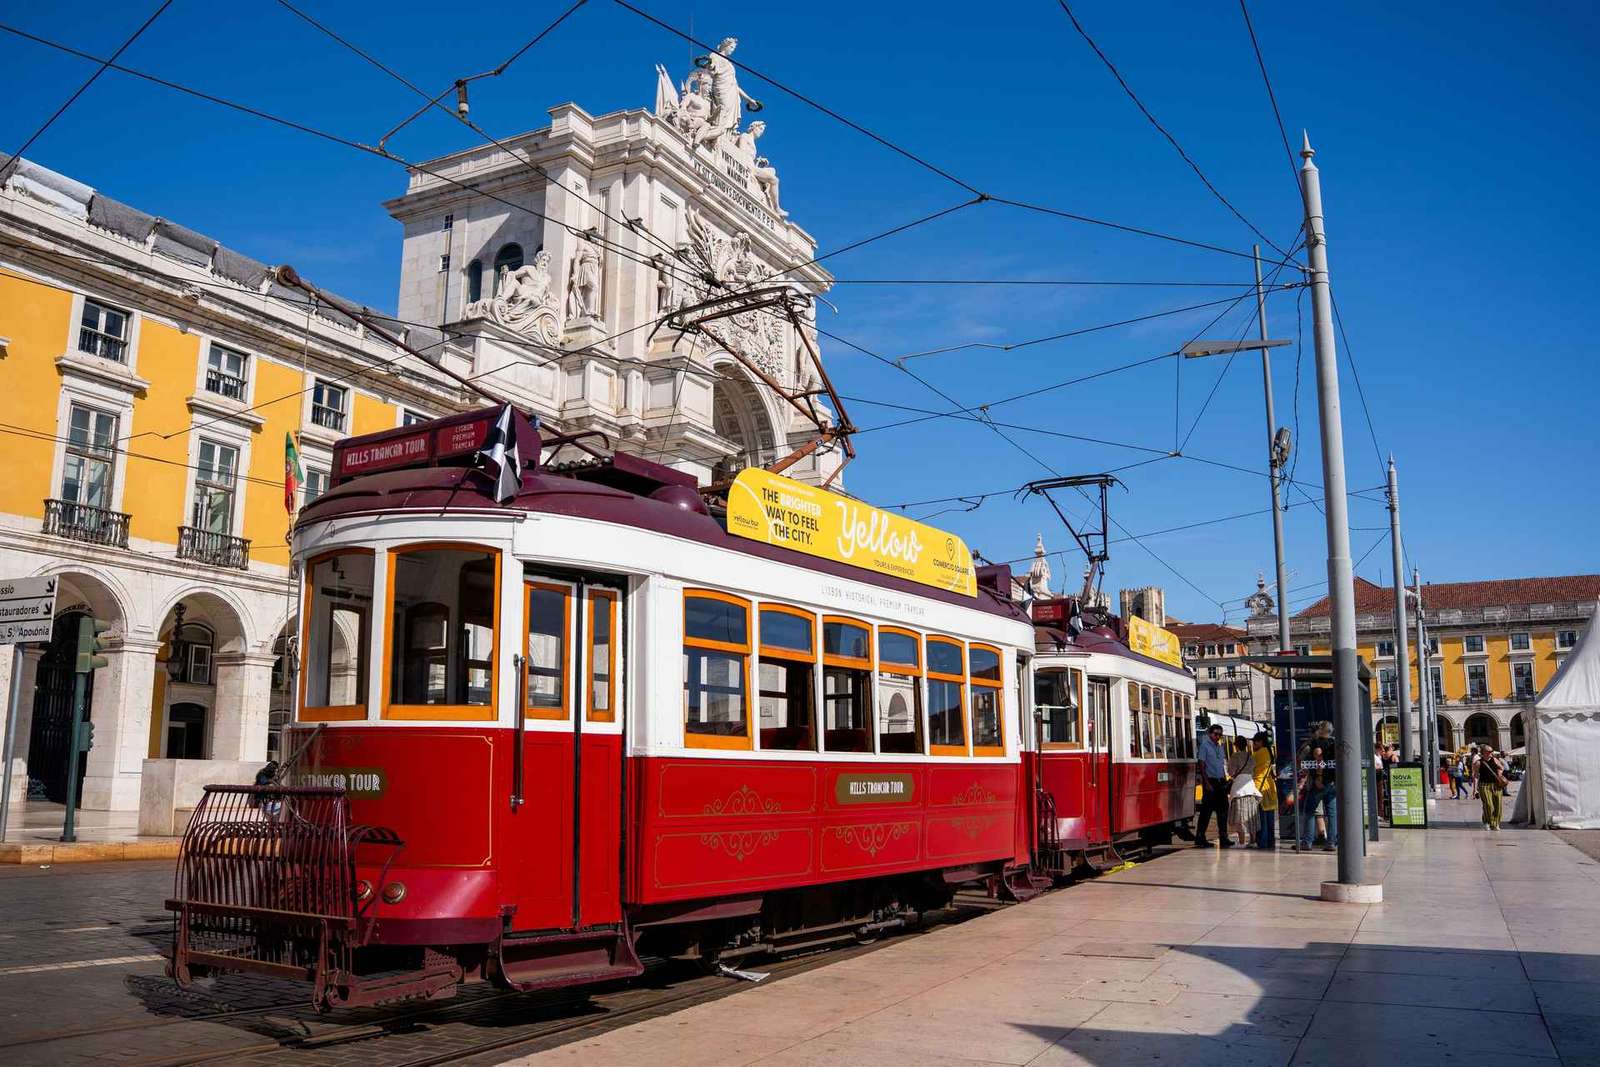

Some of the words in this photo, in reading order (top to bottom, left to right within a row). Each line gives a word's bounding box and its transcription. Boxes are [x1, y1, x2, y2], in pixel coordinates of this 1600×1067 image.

[452, 432, 475, 441] PREMIUM
[346, 452, 369, 467] HILLS
[371, 445, 403, 461] TRAMCAR
[405, 438, 425, 454] TOUR
[762, 488, 778, 503] THE
[766, 505, 786, 522] WAY
[788, 512, 800, 525] TO
[801, 516, 819, 532] FEEL
[774, 523, 789, 539] THE
[791, 529, 813, 545] CITY.
[835, 501, 923, 564] Yellow
[349, 774, 380, 791] TOUR
[849, 781, 866, 795] HILLS
